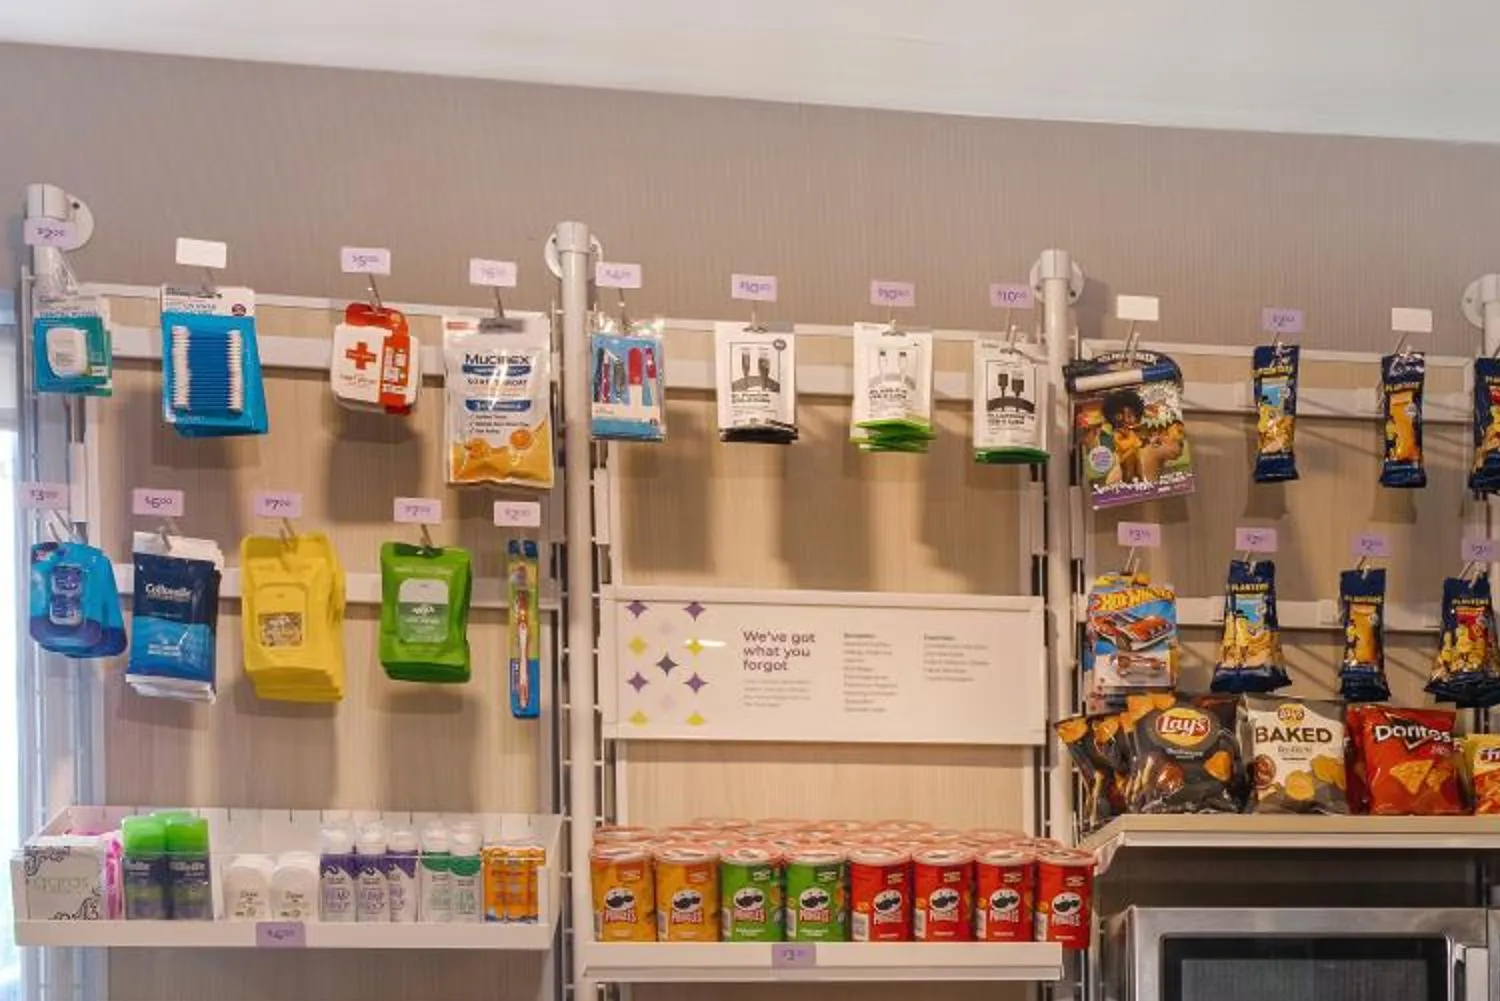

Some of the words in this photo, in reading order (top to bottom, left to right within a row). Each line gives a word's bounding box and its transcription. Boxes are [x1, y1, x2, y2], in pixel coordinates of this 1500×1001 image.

[743, 631, 787, 644] We've
[791, 633, 816, 646] got
[743, 645, 780, 657] what
[784, 647, 811, 660] you
[743, 658, 788, 673] forgot
[1255, 727, 1333, 743] BAKED
[1375, 722, 1453, 744] Doritos
